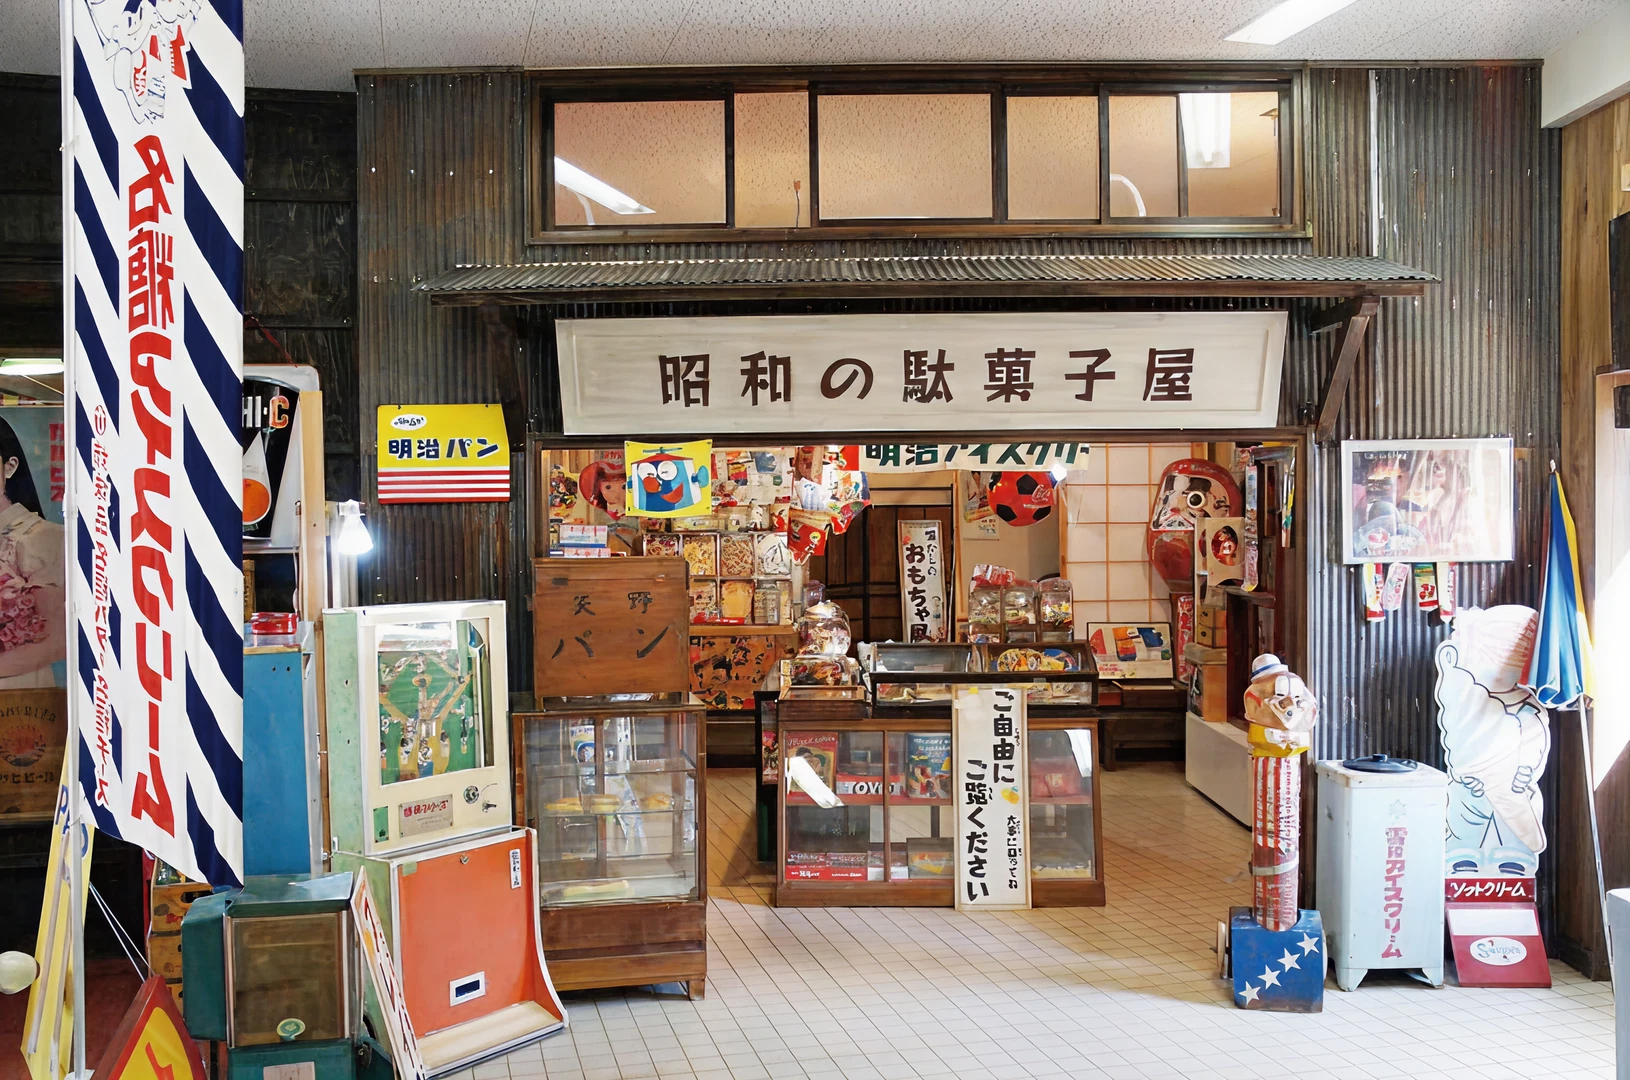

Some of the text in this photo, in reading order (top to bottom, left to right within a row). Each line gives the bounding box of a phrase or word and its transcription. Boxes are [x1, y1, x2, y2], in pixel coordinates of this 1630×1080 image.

[658, 347, 1197, 408] 昭和の駄菓子屋
[388, 438, 499, 459] 明治パン
[551, 626, 669, 659] パン
[993, 691, 1015, 783] ご自由に
[965, 759, 989, 902] ご覧ください
